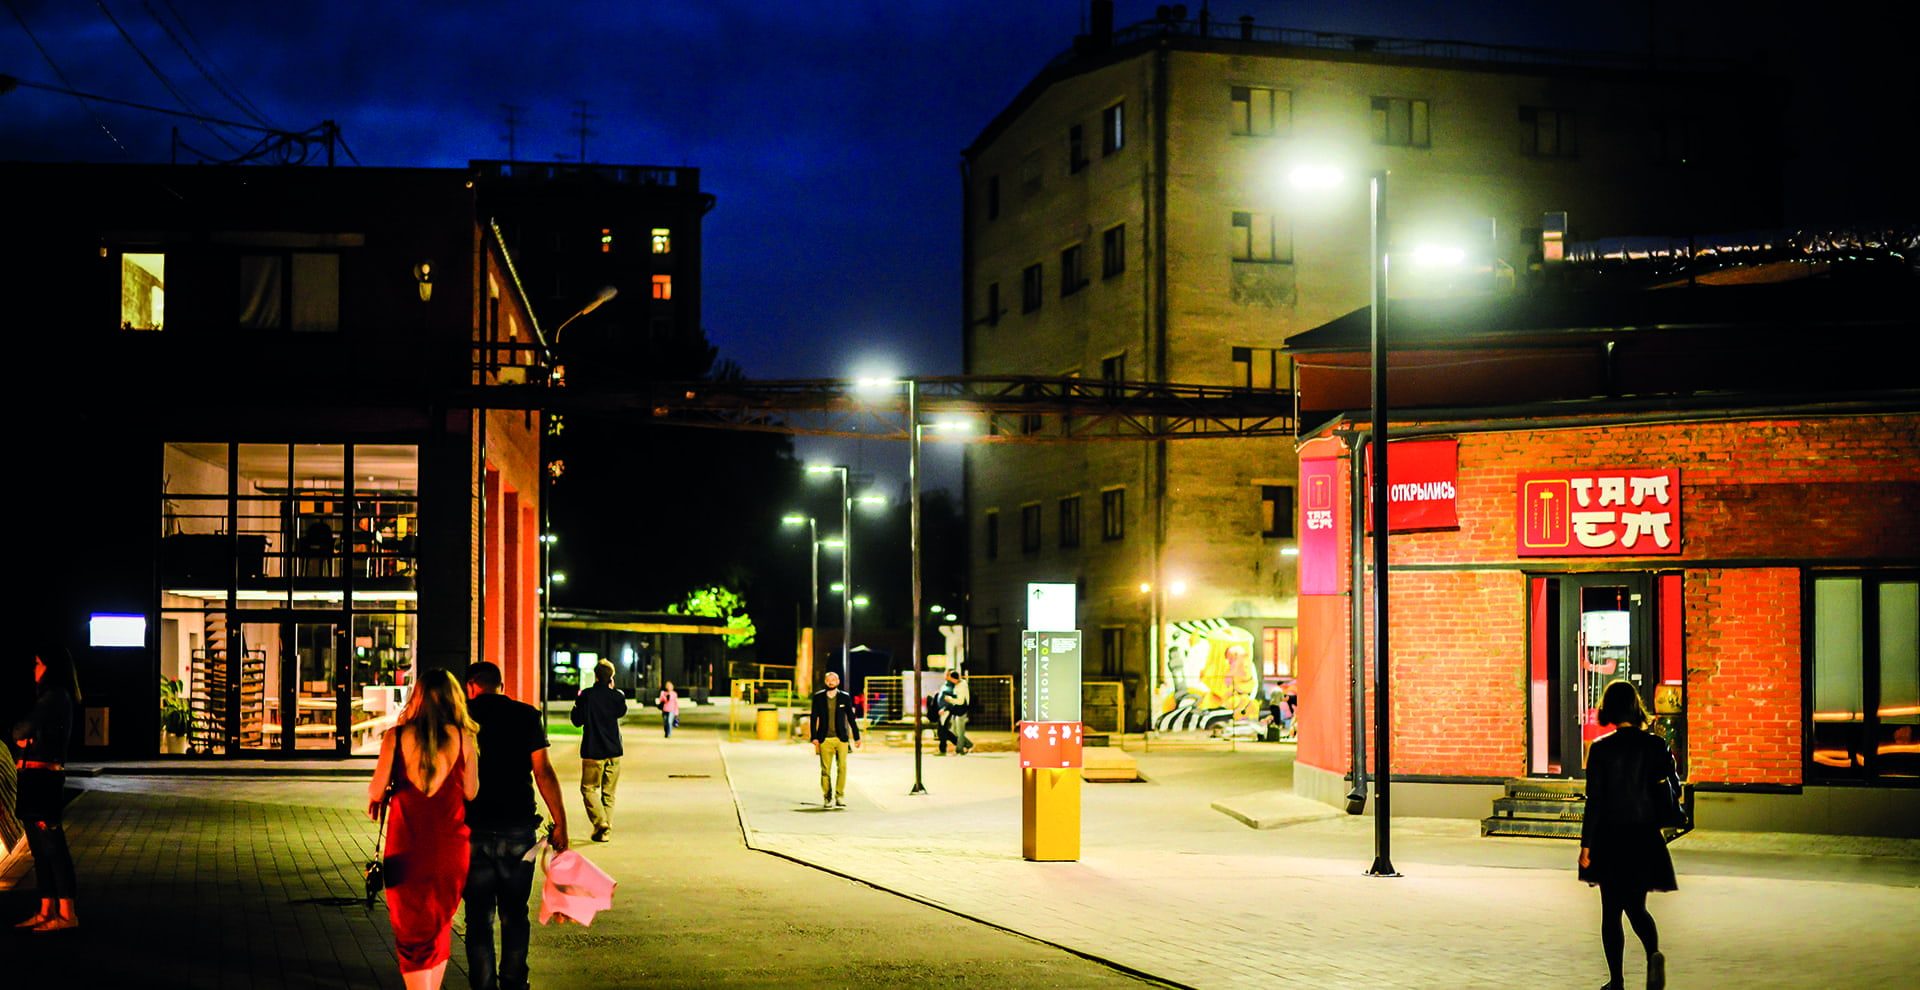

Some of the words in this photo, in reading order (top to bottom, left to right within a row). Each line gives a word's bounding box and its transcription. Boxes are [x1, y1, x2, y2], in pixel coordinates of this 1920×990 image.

[1391, 481, 1455, 502] ОТКРЫЛИСЬ
[1571, 475, 1670, 507] ТАМ
[1571, 511, 1671, 548] ЕМ
